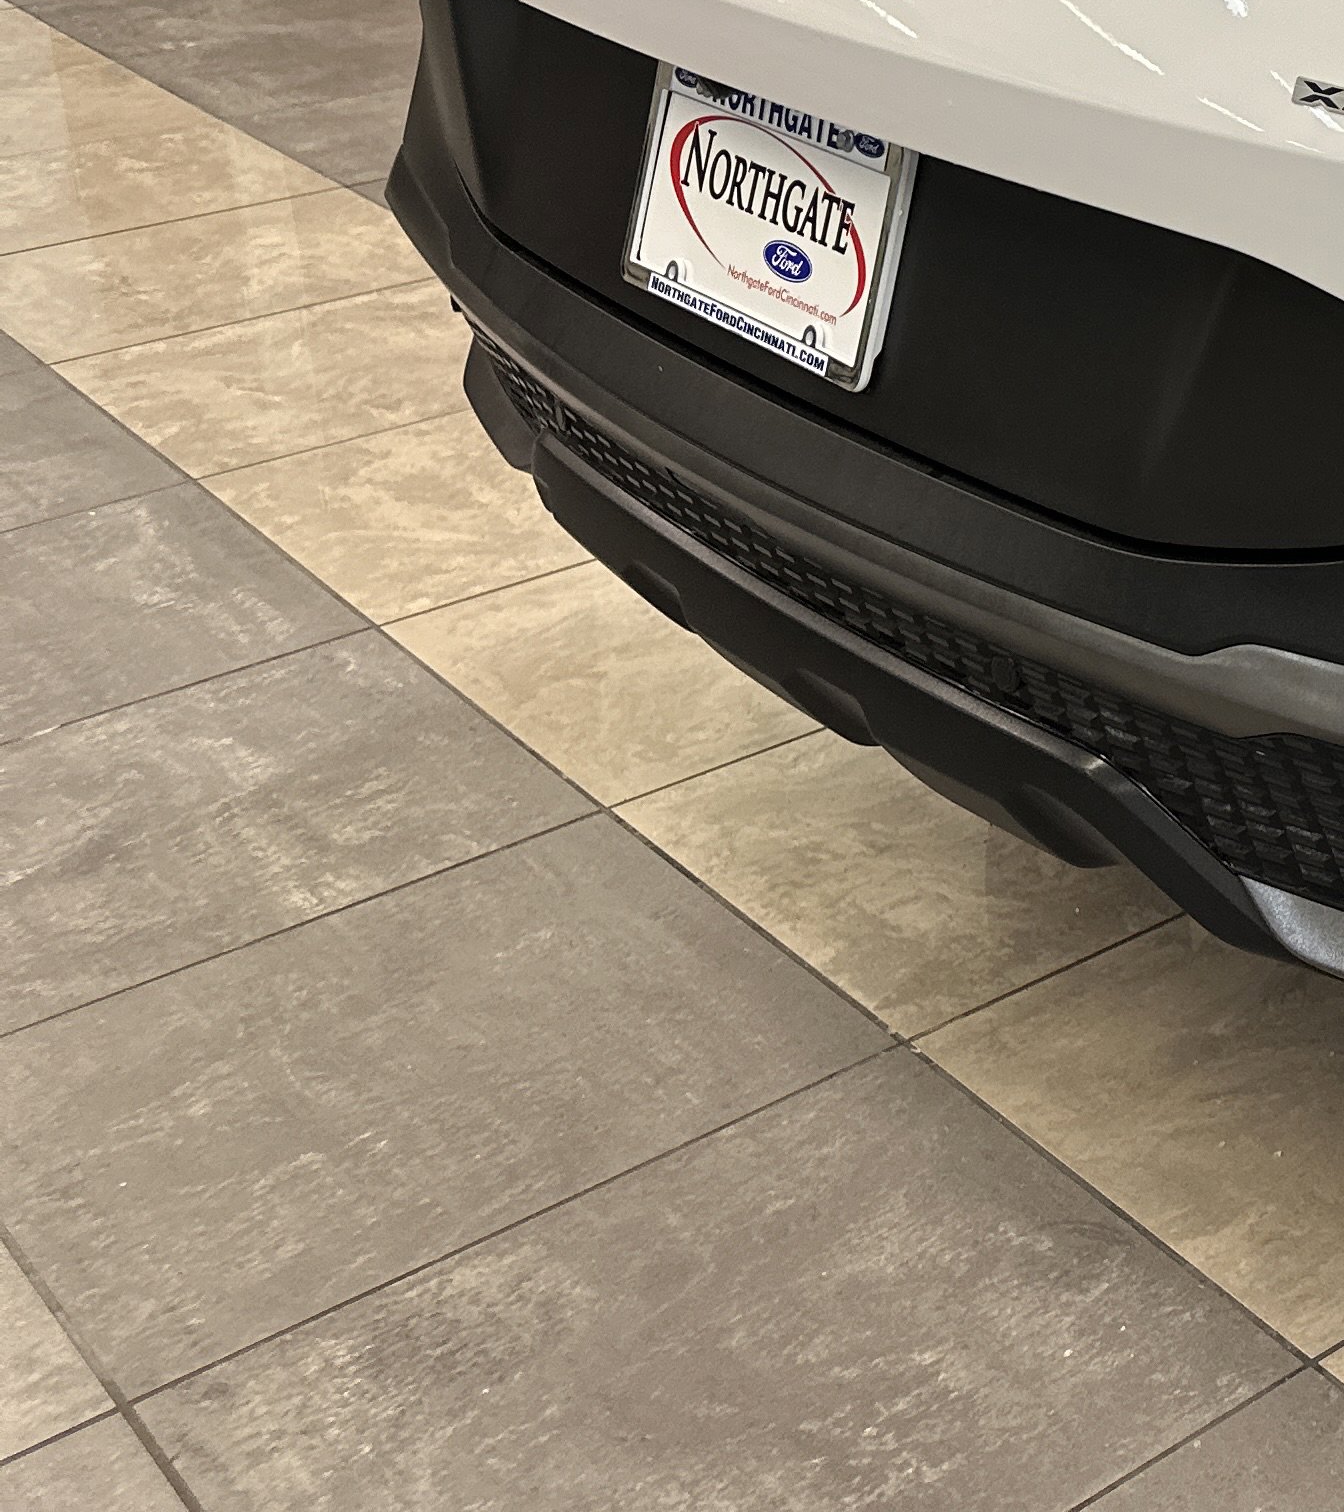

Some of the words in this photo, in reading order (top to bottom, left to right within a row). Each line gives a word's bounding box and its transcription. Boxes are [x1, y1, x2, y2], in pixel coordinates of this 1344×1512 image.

[681, 121, 856, 255] NORTHGATE
[771, 244, 805, 277] Ford
[727, 263, 837, 326] NorthgateFordCincinnati.com
